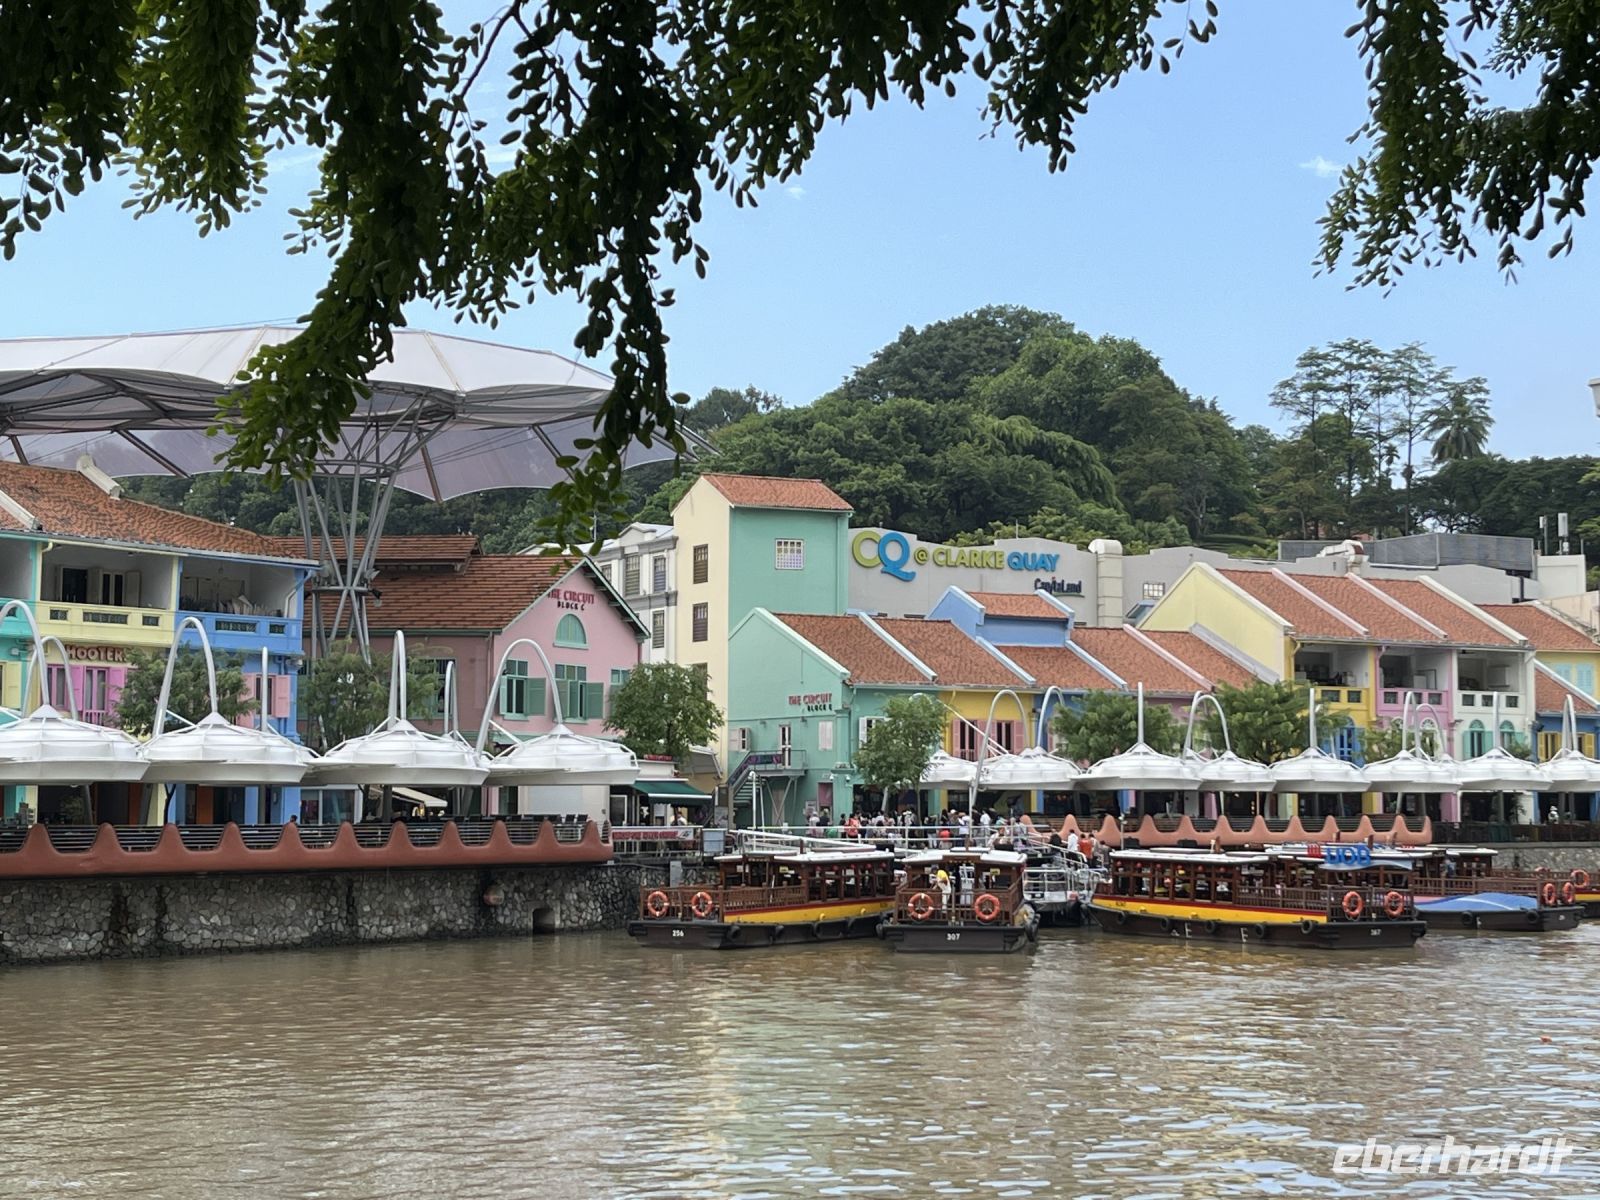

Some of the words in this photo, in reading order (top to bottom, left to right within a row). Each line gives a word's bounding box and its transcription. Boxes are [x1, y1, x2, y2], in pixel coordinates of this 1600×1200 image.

[852, 530, 916, 582] CQ
[914, 547, 929, 565] @
[932, 547, 1005, 569] CLARKE
[1007, 551, 1060, 572] QUAY
[564, 590, 595, 605] CIRCUIT
[557, 601, 579, 610] BLOCK
[788, 695, 801, 706] THE
[803, 692, 833, 704] CIRCUIT
[807, 703, 827, 712] BLOCK
[1324, 842, 1371, 866] UOB
[947, 932, 961, 941] 307
